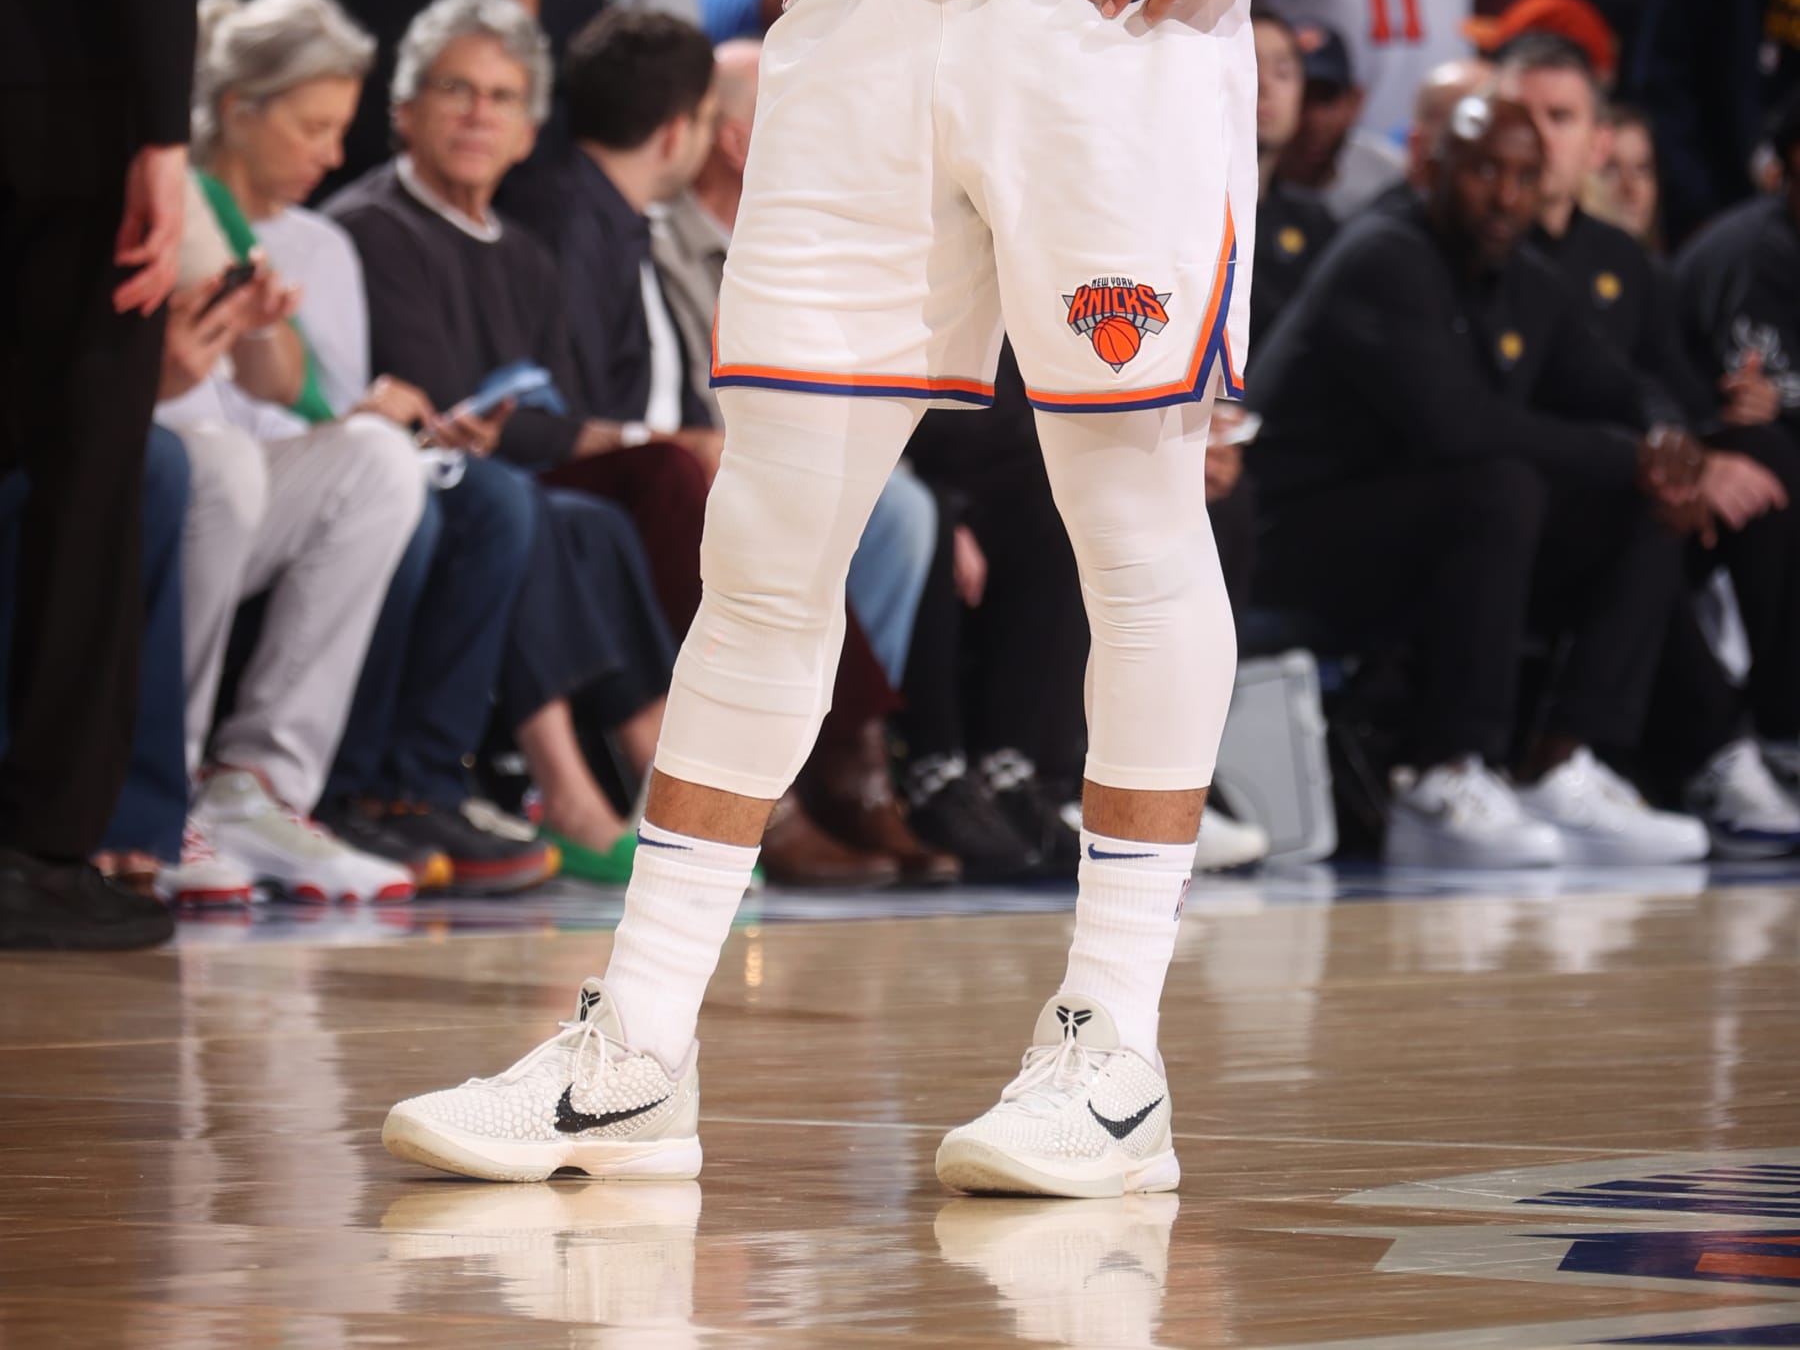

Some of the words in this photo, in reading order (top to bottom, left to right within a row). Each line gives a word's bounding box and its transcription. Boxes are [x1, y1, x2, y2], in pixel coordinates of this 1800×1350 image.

[1091, 277, 1109, 288] NEW
[1111, 276, 1134, 288] YORK
[1067, 283, 1169, 326] KNICKS
